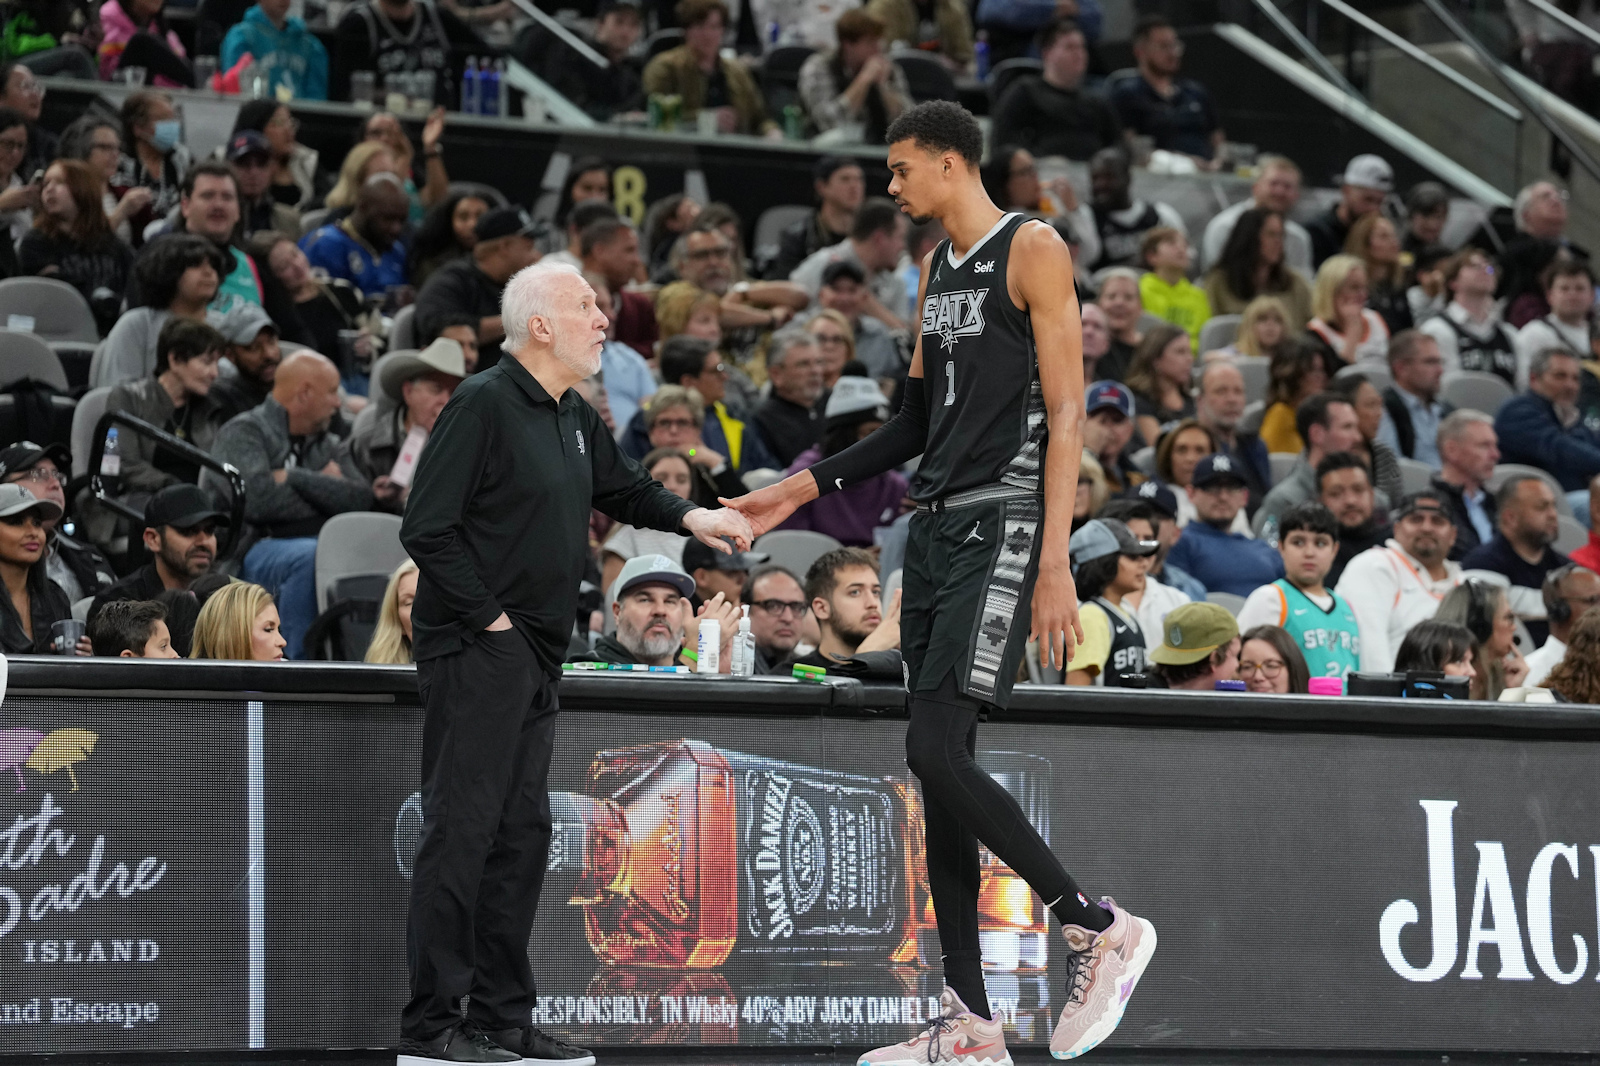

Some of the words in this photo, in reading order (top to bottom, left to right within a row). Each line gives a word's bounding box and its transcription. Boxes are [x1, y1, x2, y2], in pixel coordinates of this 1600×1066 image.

[922, 288, 989, 336] SATX
[944, 361, 956, 406] 1
[763, 872, 794, 940] JACK
[1379, 800, 1600, 985] JAC
[24, 940, 159, 962] ISLAND
[0, 998, 40, 1023] nd
[50, 998, 159, 1027] Escape
[660, 996, 683, 1023] TN
[783, 996, 816, 1023] ABV
[820, 996, 865, 1024] JACK
[867, 996, 927, 1024] DANIEL
